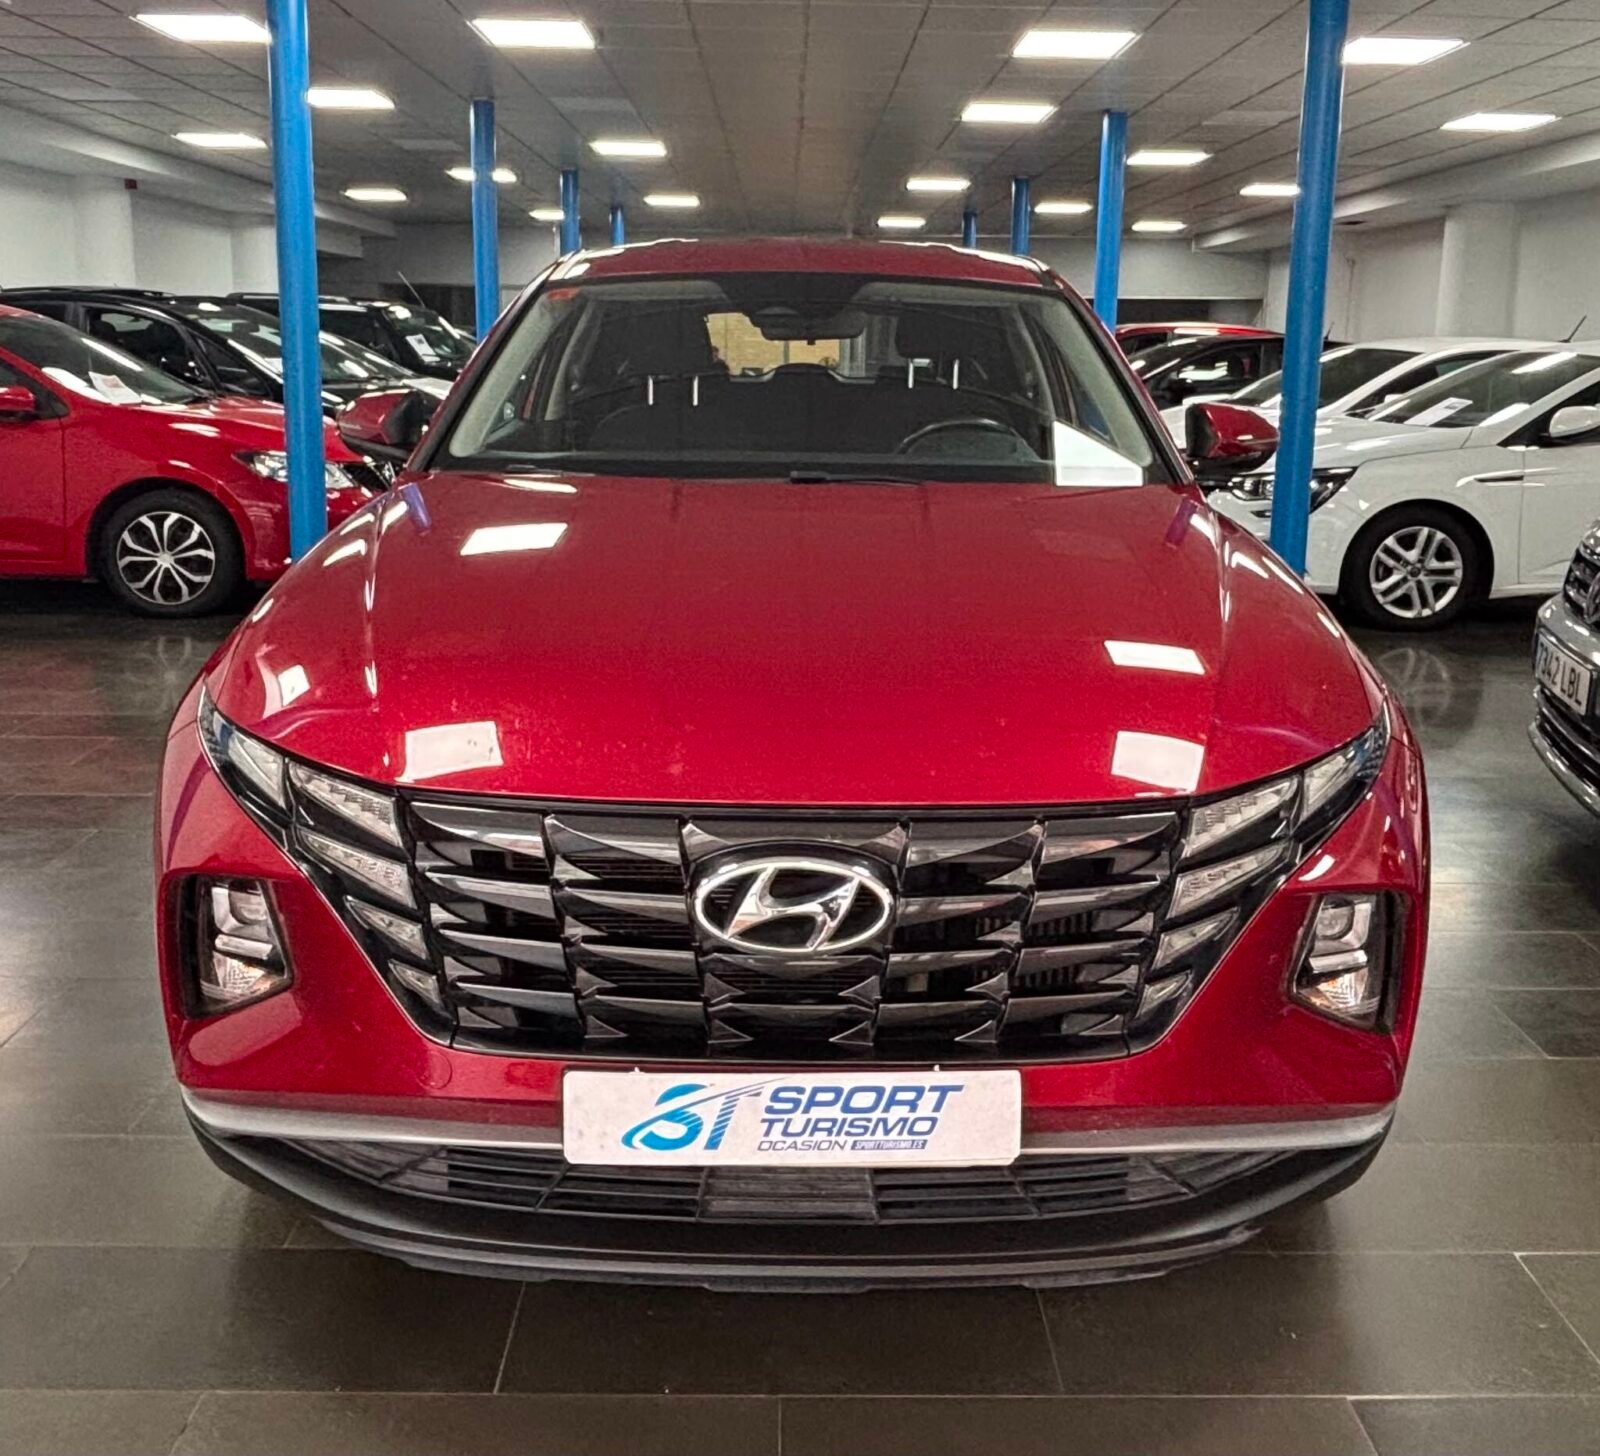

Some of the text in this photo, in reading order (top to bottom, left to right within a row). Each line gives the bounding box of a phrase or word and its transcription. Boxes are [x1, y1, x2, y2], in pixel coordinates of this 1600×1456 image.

[1560, 661, 1582, 706] LBL
[764, 1084, 965, 1115] SPORT
[760, 1116, 939, 1138] TURISMO
[757, 1139, 848, 1151] OCASION
